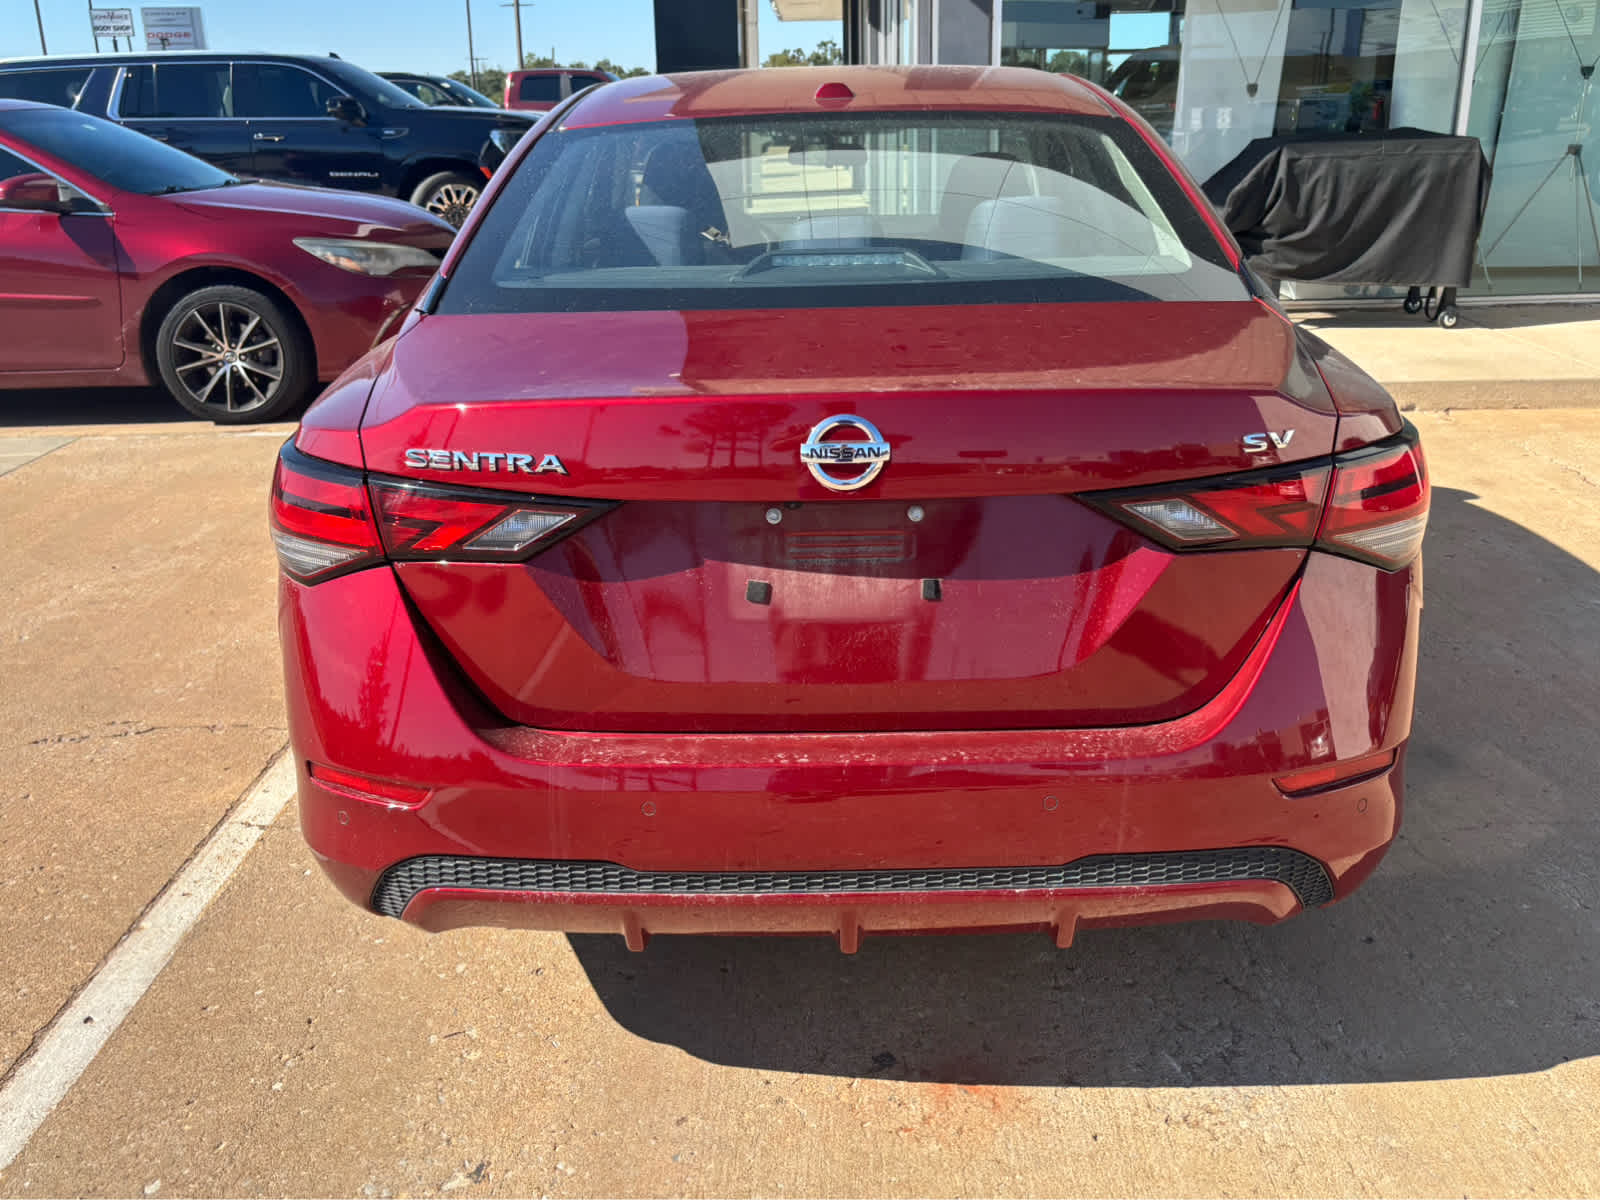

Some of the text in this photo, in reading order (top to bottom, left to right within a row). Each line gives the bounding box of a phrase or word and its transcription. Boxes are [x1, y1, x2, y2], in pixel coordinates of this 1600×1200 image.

[147, 31, 192, 39] DODGE
[1242, 428, 1296, 454] SV
[403, 447, 568, 475] SENTRA
[809, 446, 881, 459] NISSAN
